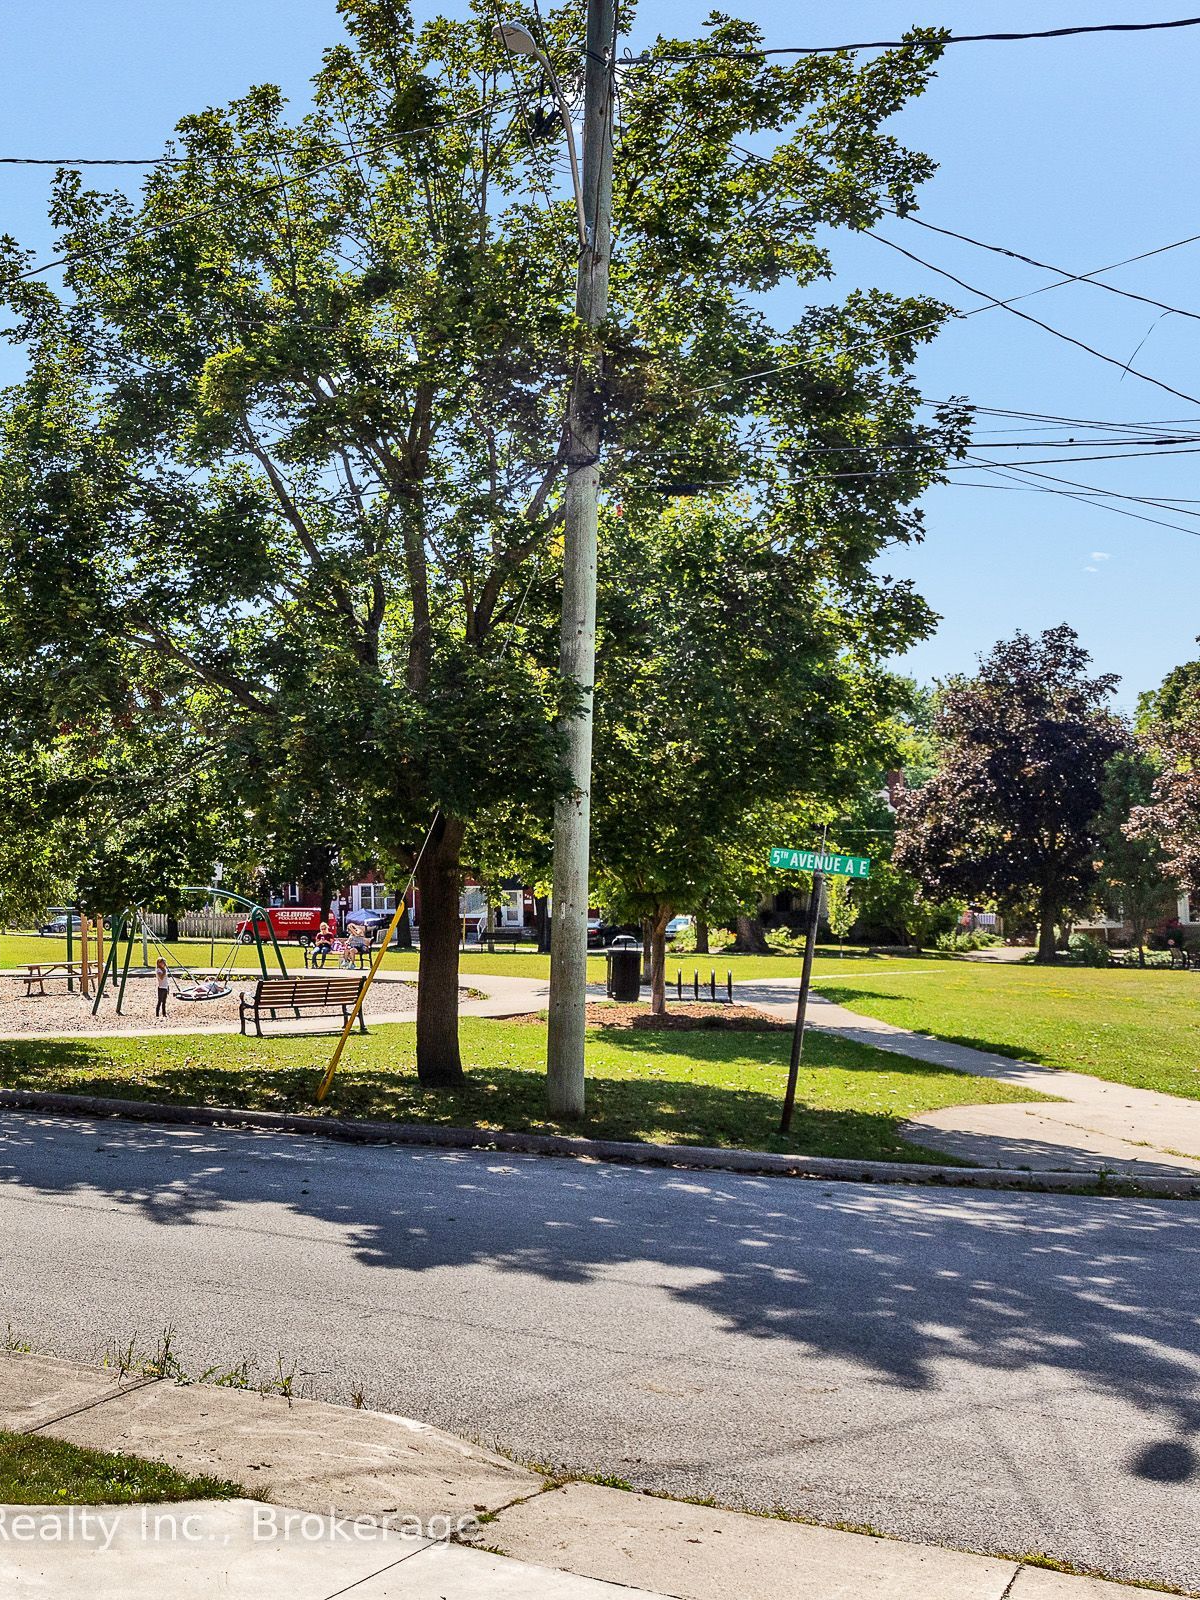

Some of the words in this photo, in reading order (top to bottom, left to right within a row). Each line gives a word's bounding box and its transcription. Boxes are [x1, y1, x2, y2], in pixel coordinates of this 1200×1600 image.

[773, 850, 789, 865] 5TH
[790, 852, 842, 872] AVENUE
[845, 859, 854, 874] A
[859, 860, 868, 876] E
